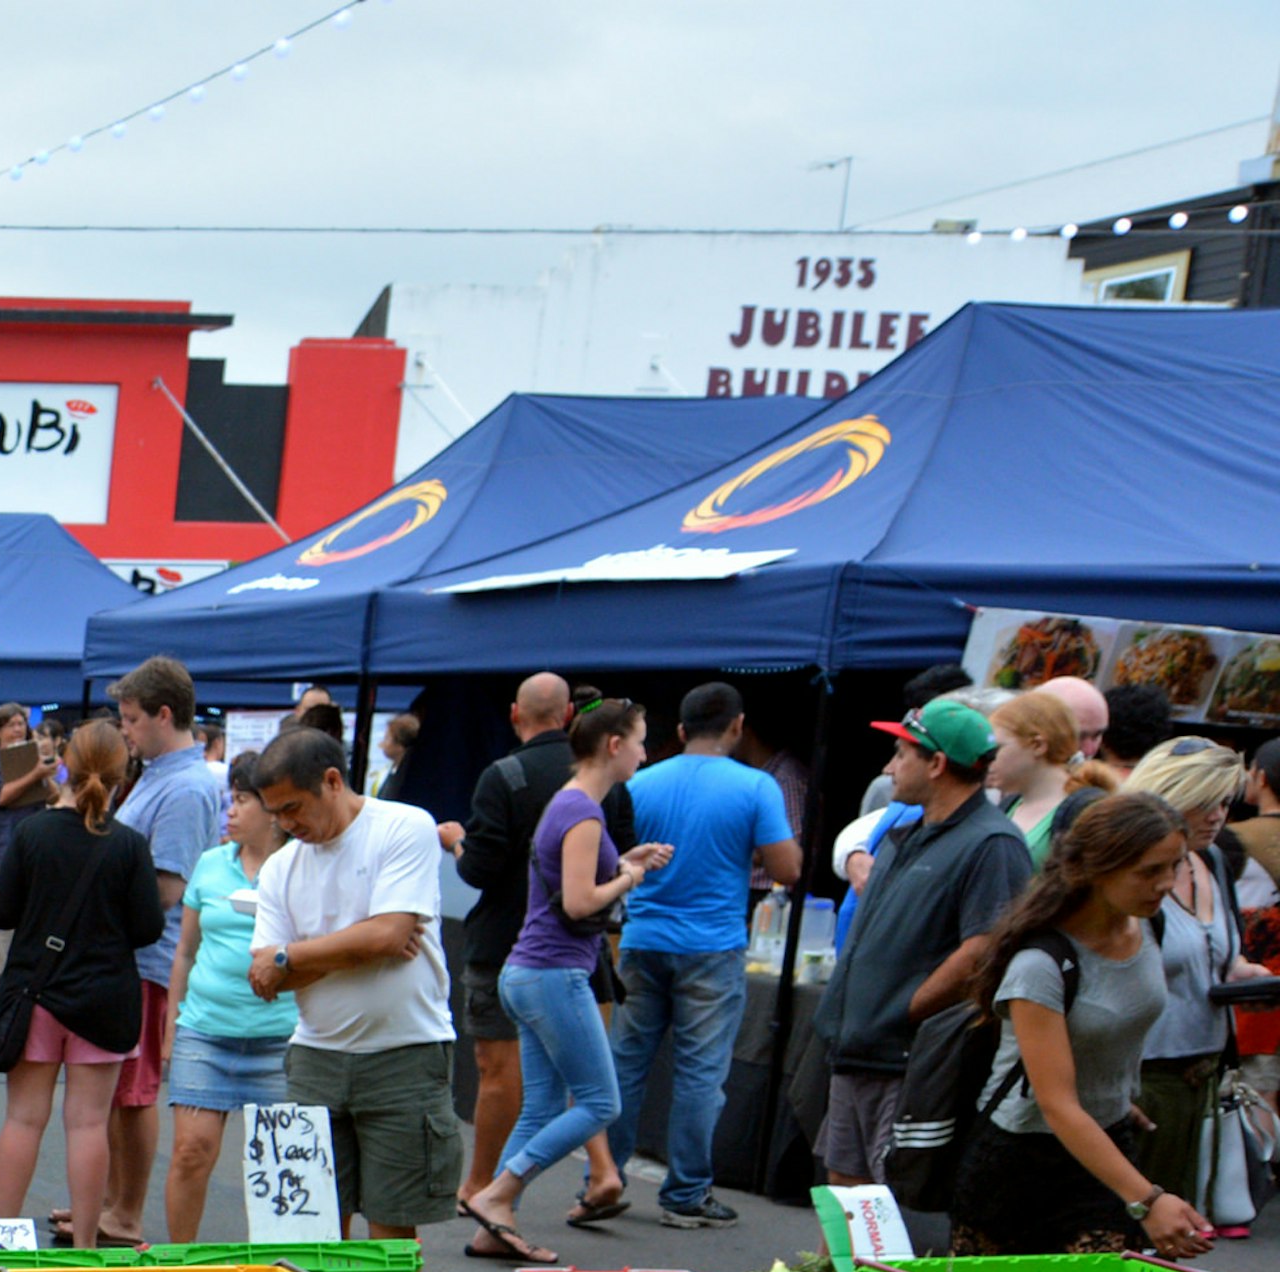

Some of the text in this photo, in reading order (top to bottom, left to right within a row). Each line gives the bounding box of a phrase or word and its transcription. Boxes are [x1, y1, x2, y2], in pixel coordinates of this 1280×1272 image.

[795, 257, 877, 290] 1935
[730, 306, 931, 350] JUBILEE
[707, 368, 876, 398] BUILD
[248, 1171, 270, 1198] 3
[272, 1189, 320, 1216] $2
[860, 1200, 886, 1260] NORMAL
